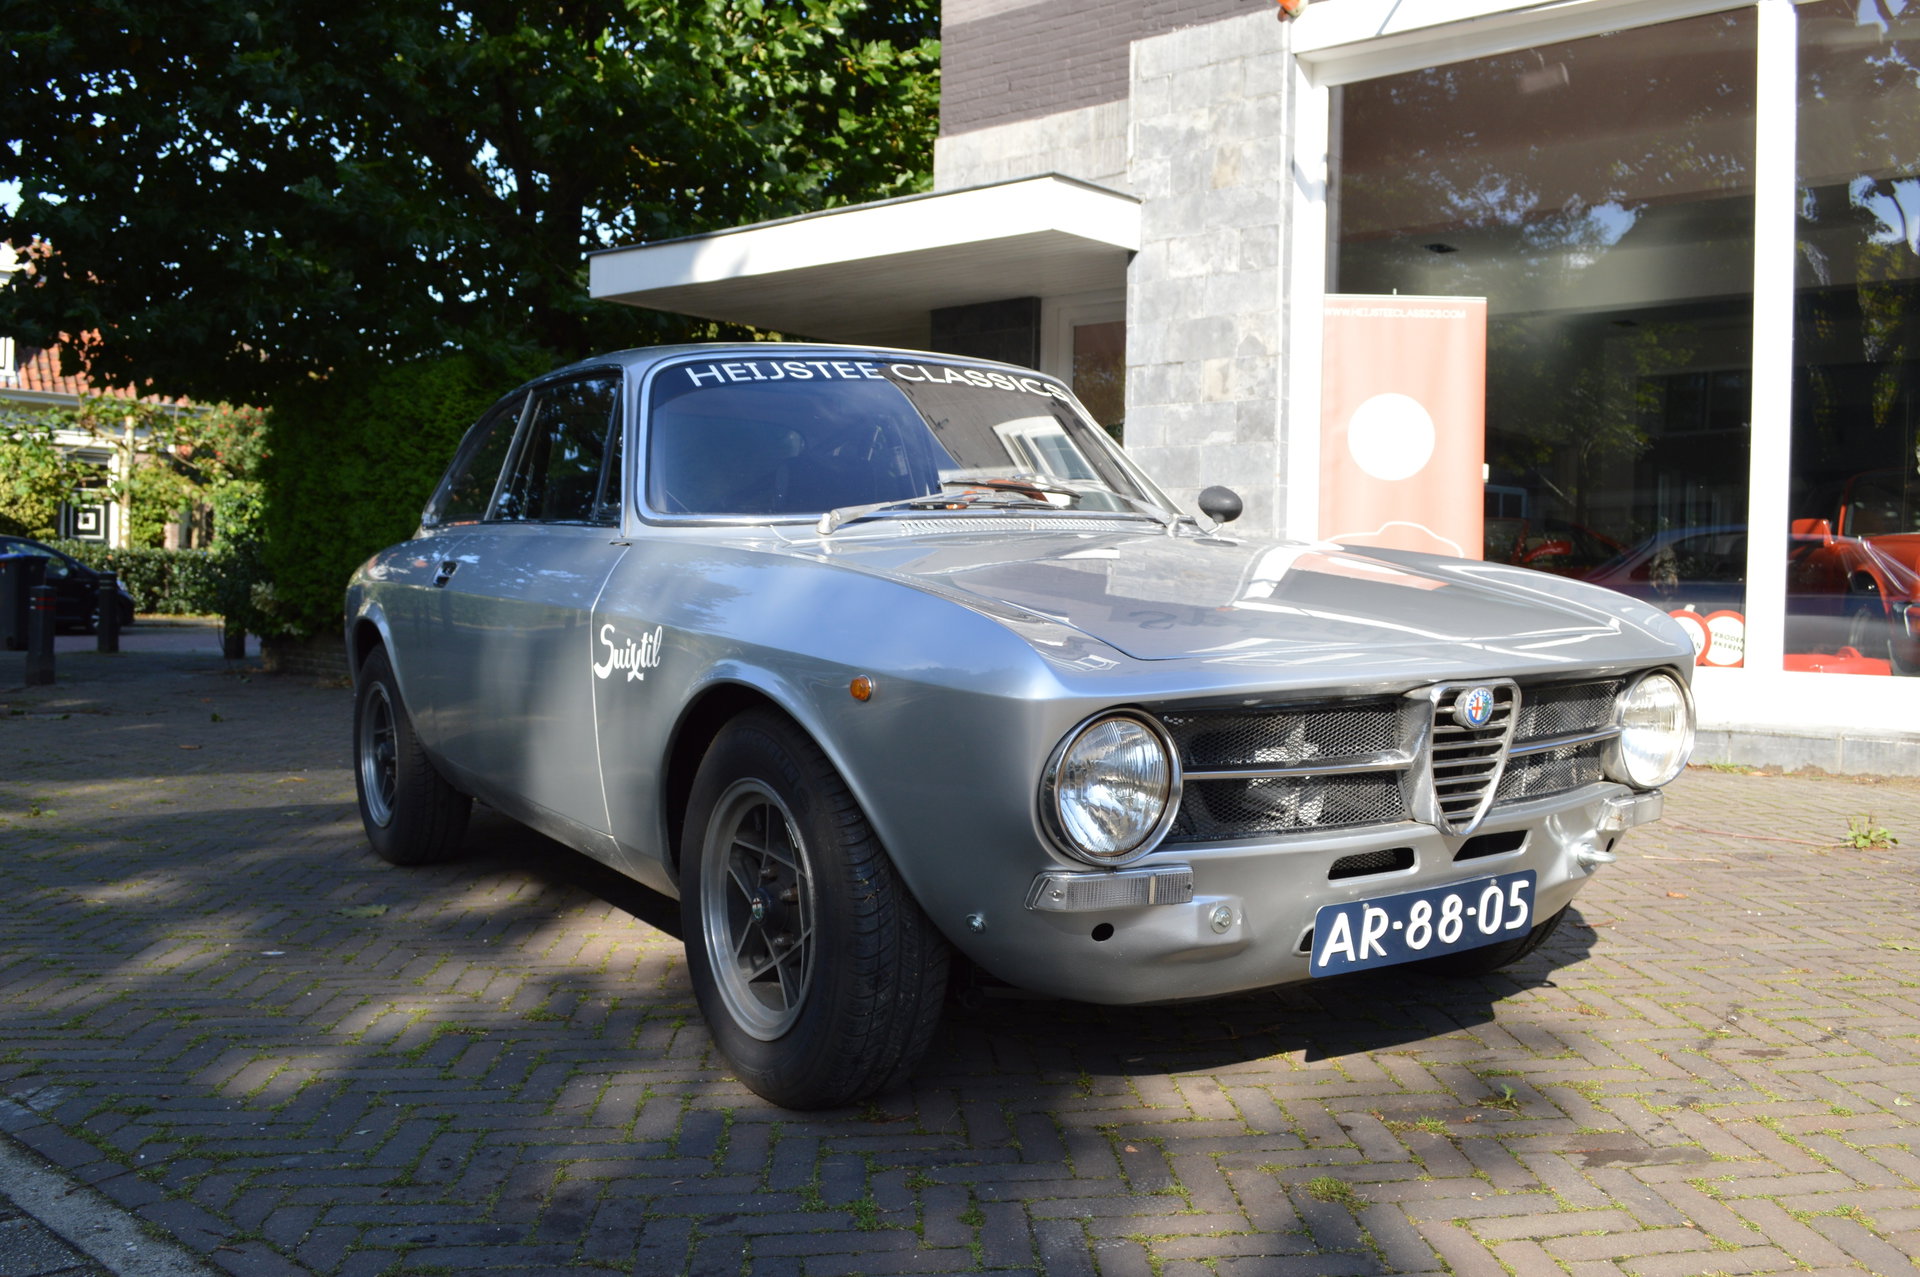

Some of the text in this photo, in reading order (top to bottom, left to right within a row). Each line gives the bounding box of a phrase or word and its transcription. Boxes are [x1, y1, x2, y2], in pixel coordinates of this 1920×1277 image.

[685, 361, 1071, 402] HEIJSTEE CLASSICS
[1318, 879, 1530, 967] AR-88-05
